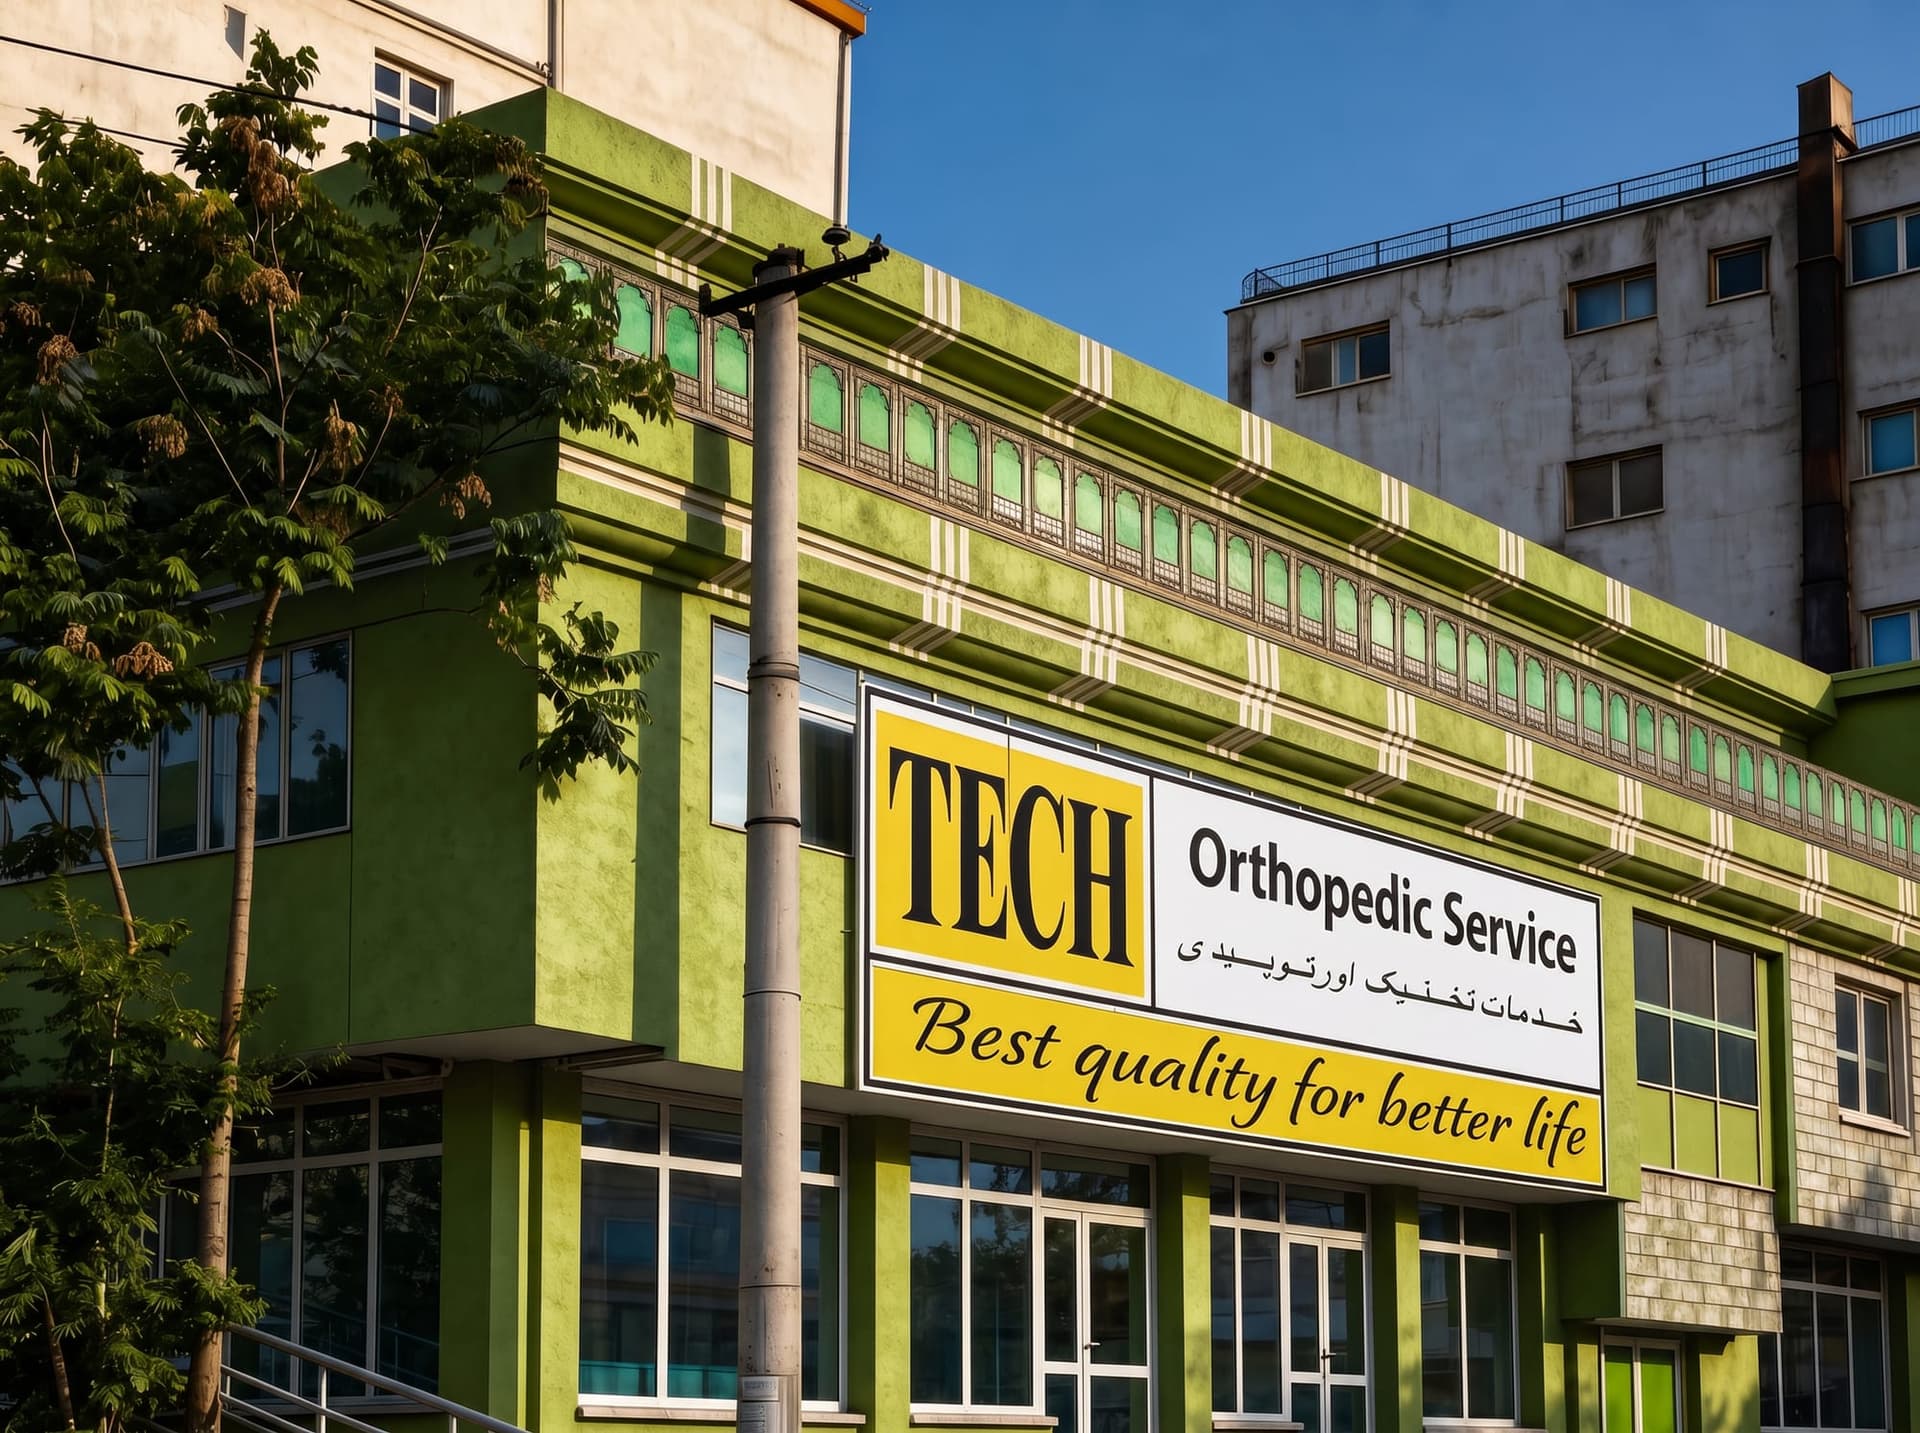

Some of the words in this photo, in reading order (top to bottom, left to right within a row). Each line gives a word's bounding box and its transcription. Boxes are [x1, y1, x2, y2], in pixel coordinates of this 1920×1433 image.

[889, 746, 1134, 968] TECH
[1189, 827, 1433, 940] Orthopedic
[1443, 891, 1577, 974] Service
[912, 996, 1061, 1070] Best
[1075, 1035, 1278, 1129] quality
[1289, 1057, 1365, 1127] for
[1378, 1071, 1513, 1143] better
[1523, 1095, 1587, 1169] life
[1481, 994, 1583, 1034] خدمات
